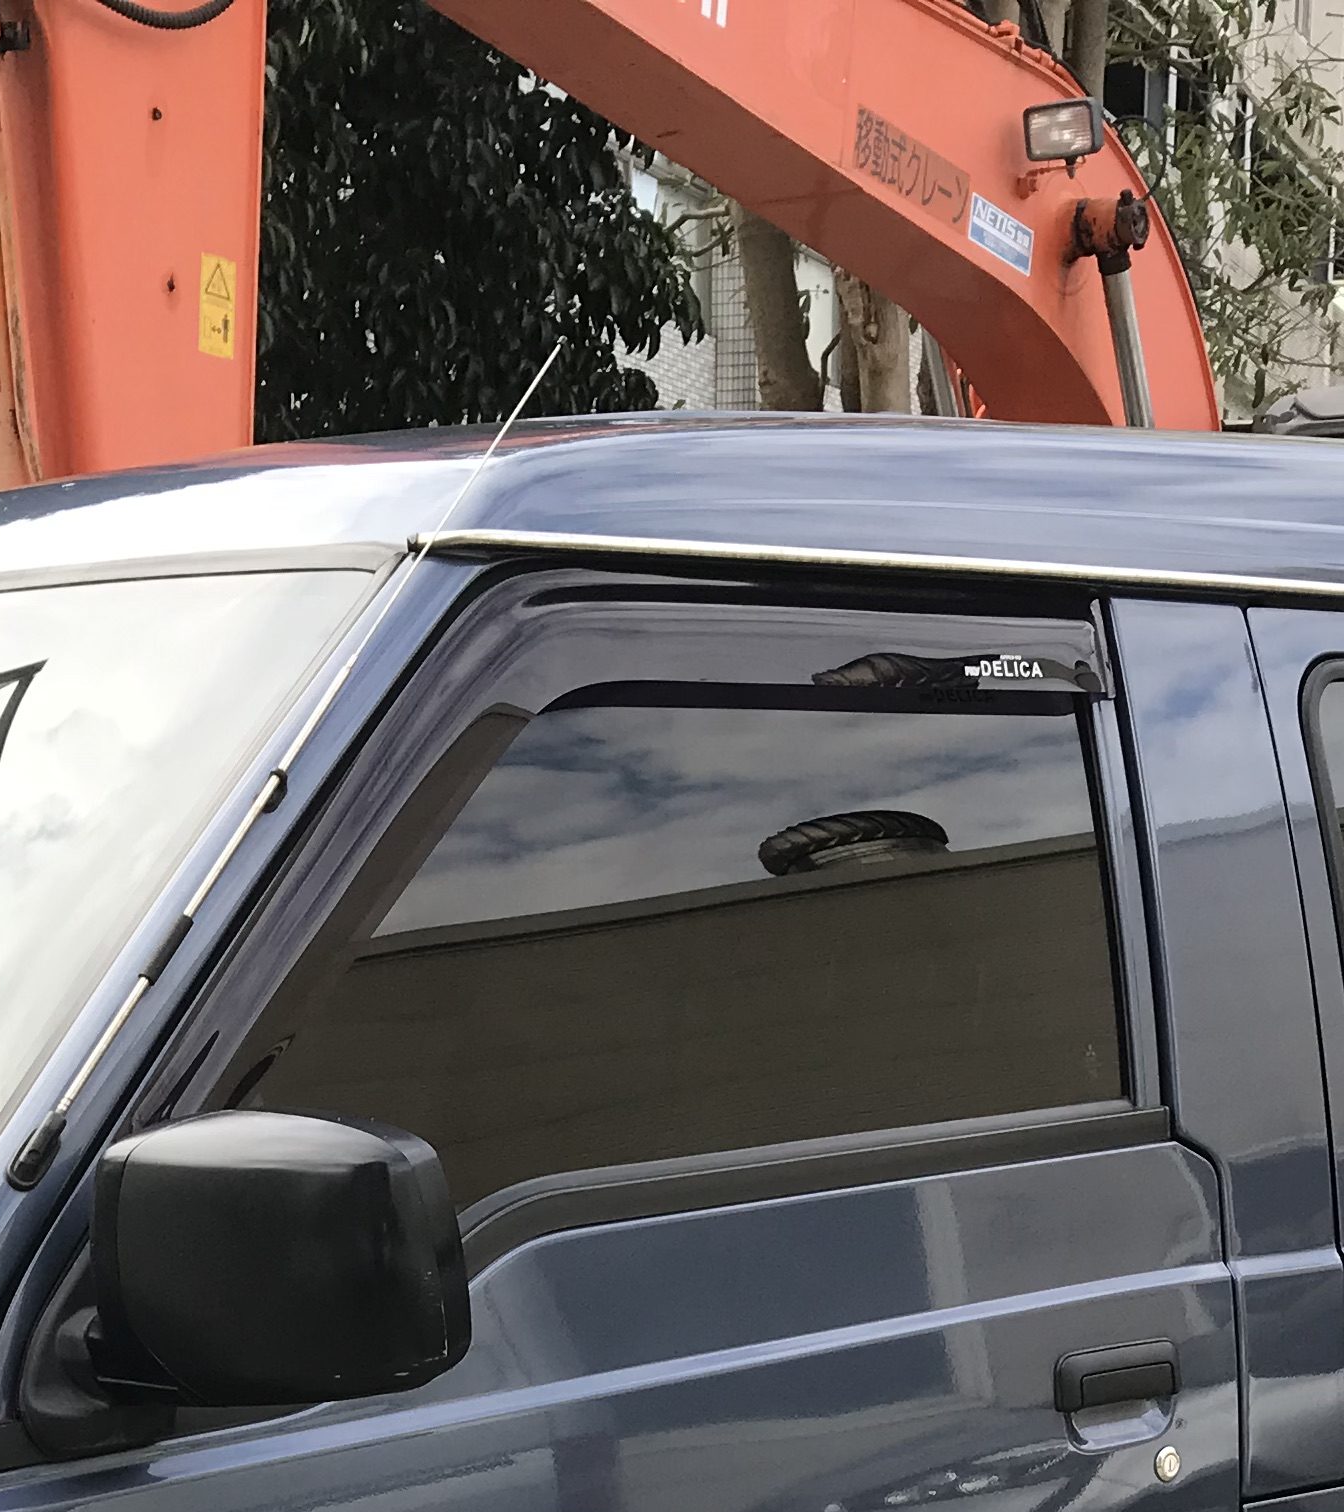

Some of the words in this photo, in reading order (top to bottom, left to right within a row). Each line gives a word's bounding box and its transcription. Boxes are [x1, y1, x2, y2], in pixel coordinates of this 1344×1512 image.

[856, 107, 969, 223] 移動式クレーン
[974, 199, 1017, 237] NETIS
[980, 660, 1043, 678] DELICA
